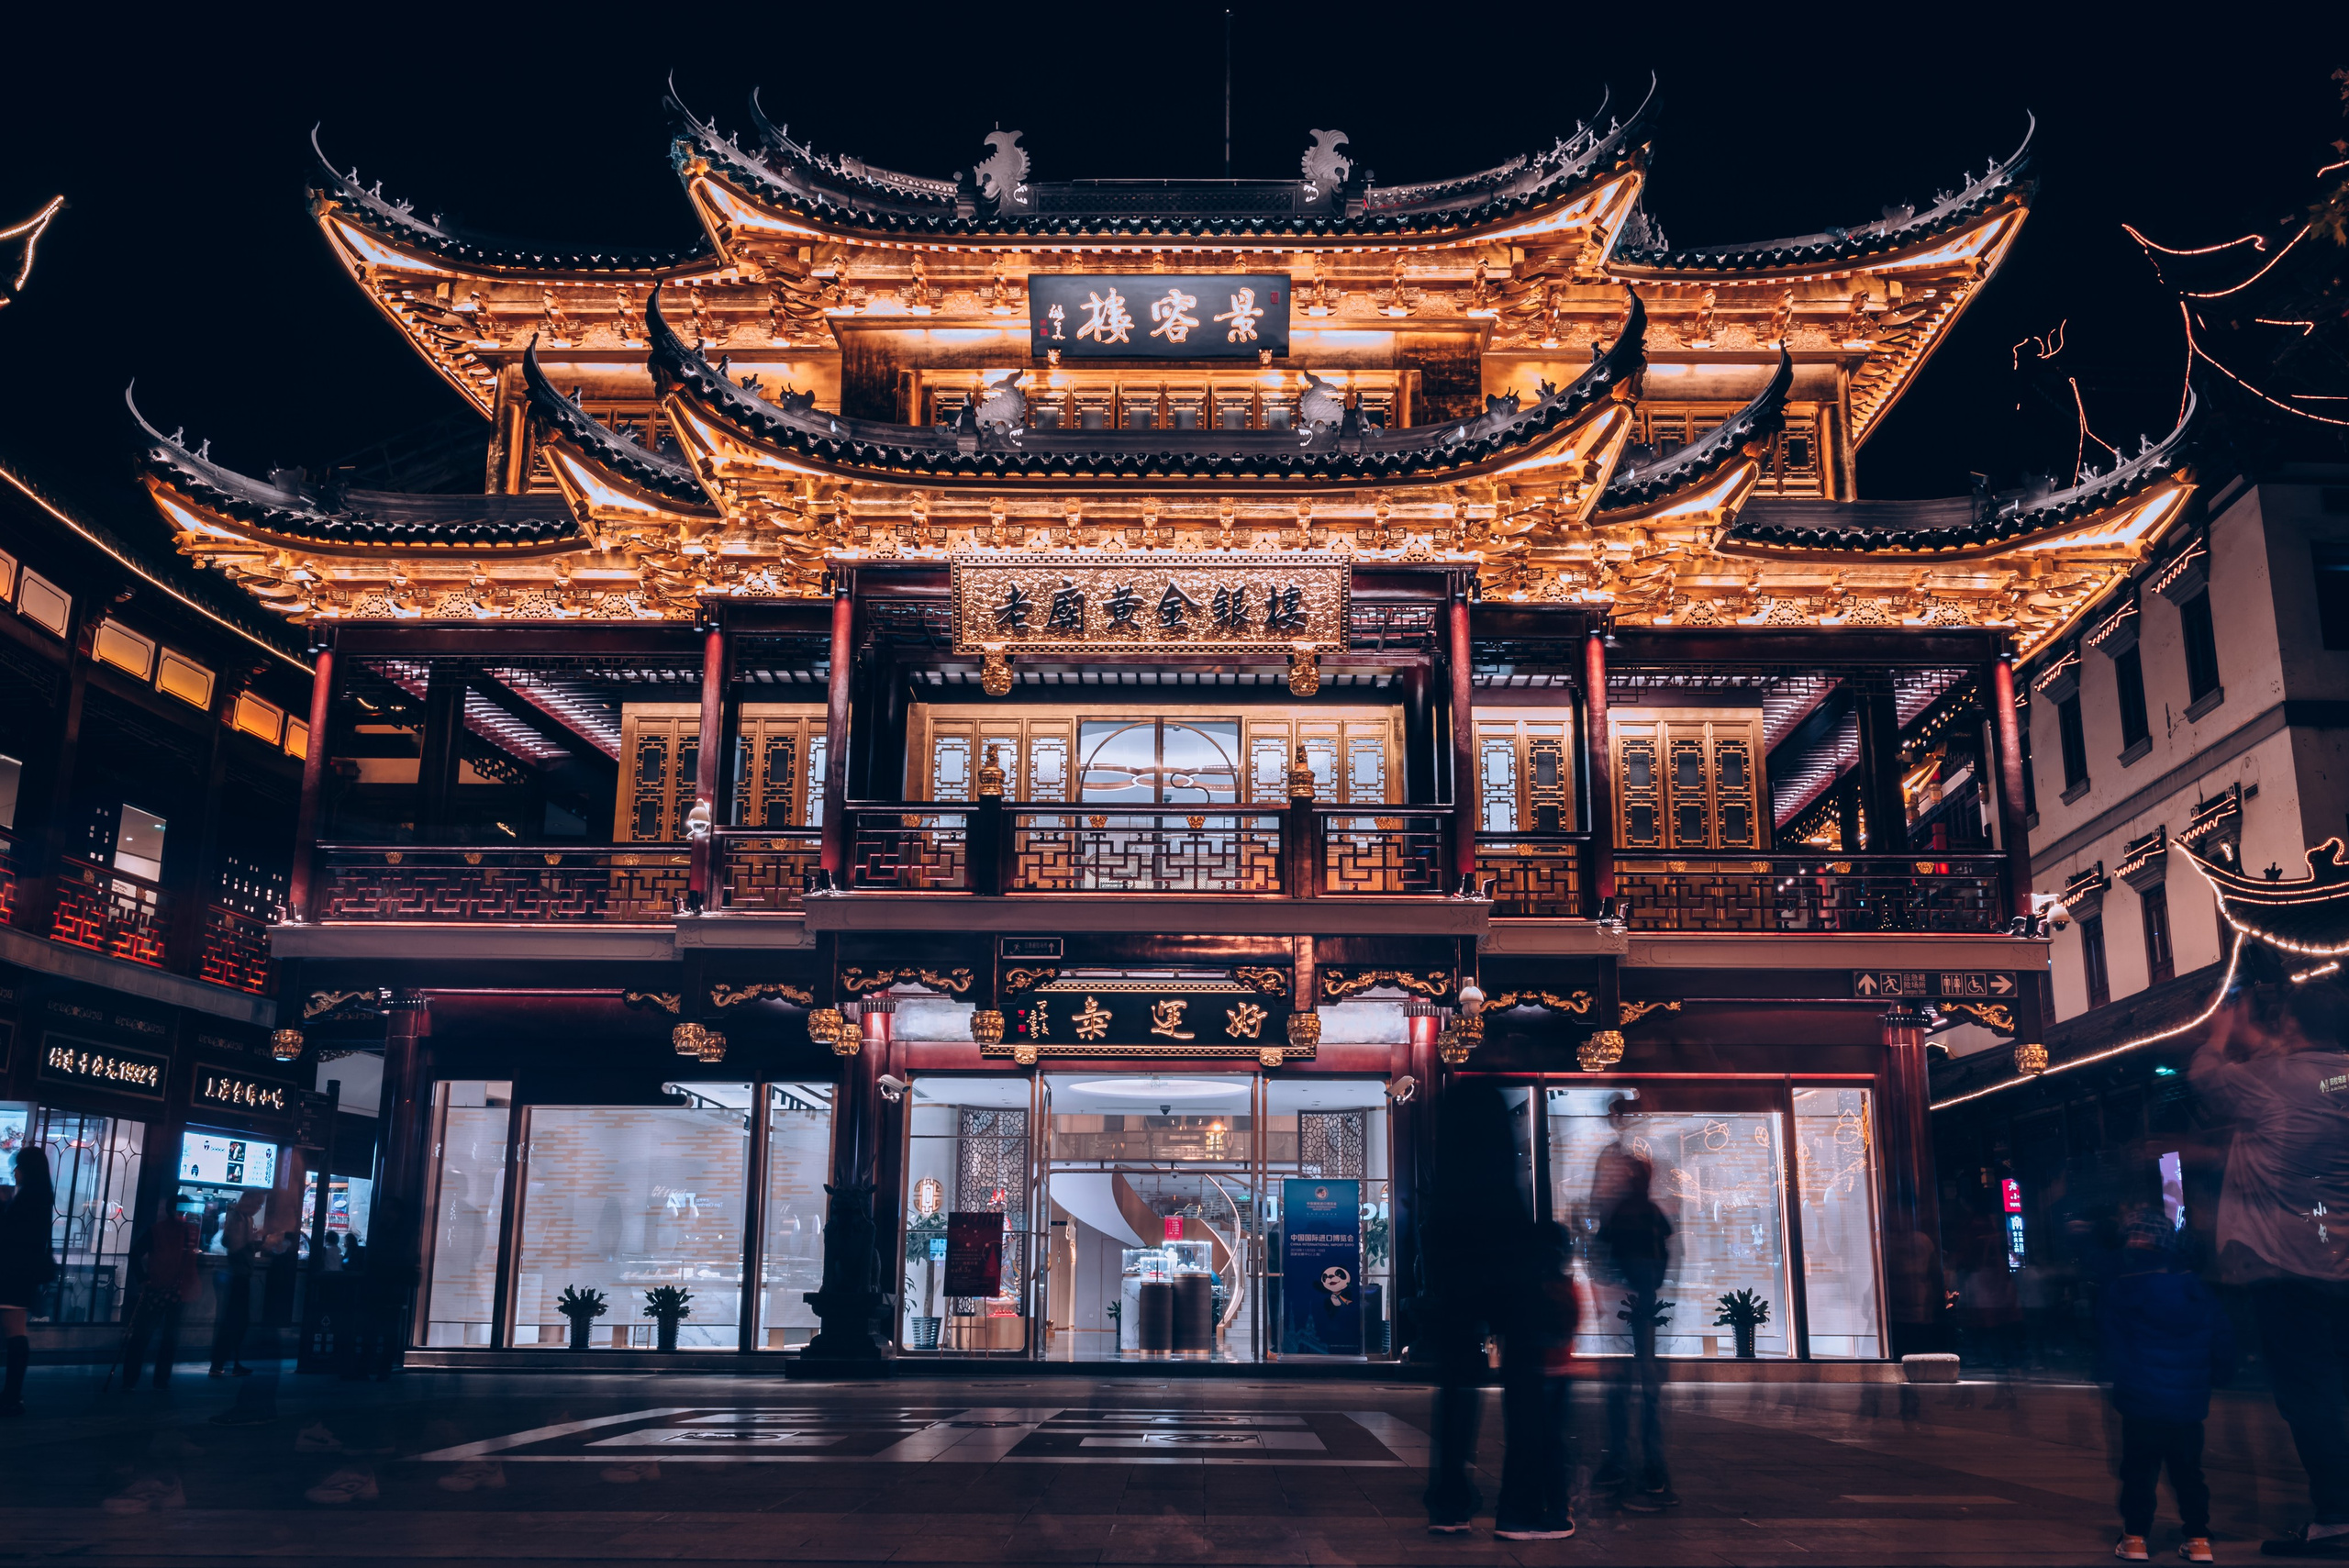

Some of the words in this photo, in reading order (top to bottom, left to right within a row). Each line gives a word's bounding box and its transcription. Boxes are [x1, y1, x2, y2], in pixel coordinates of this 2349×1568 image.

[1290, 1233, 1354, 1242] 中国国际进口博览会
